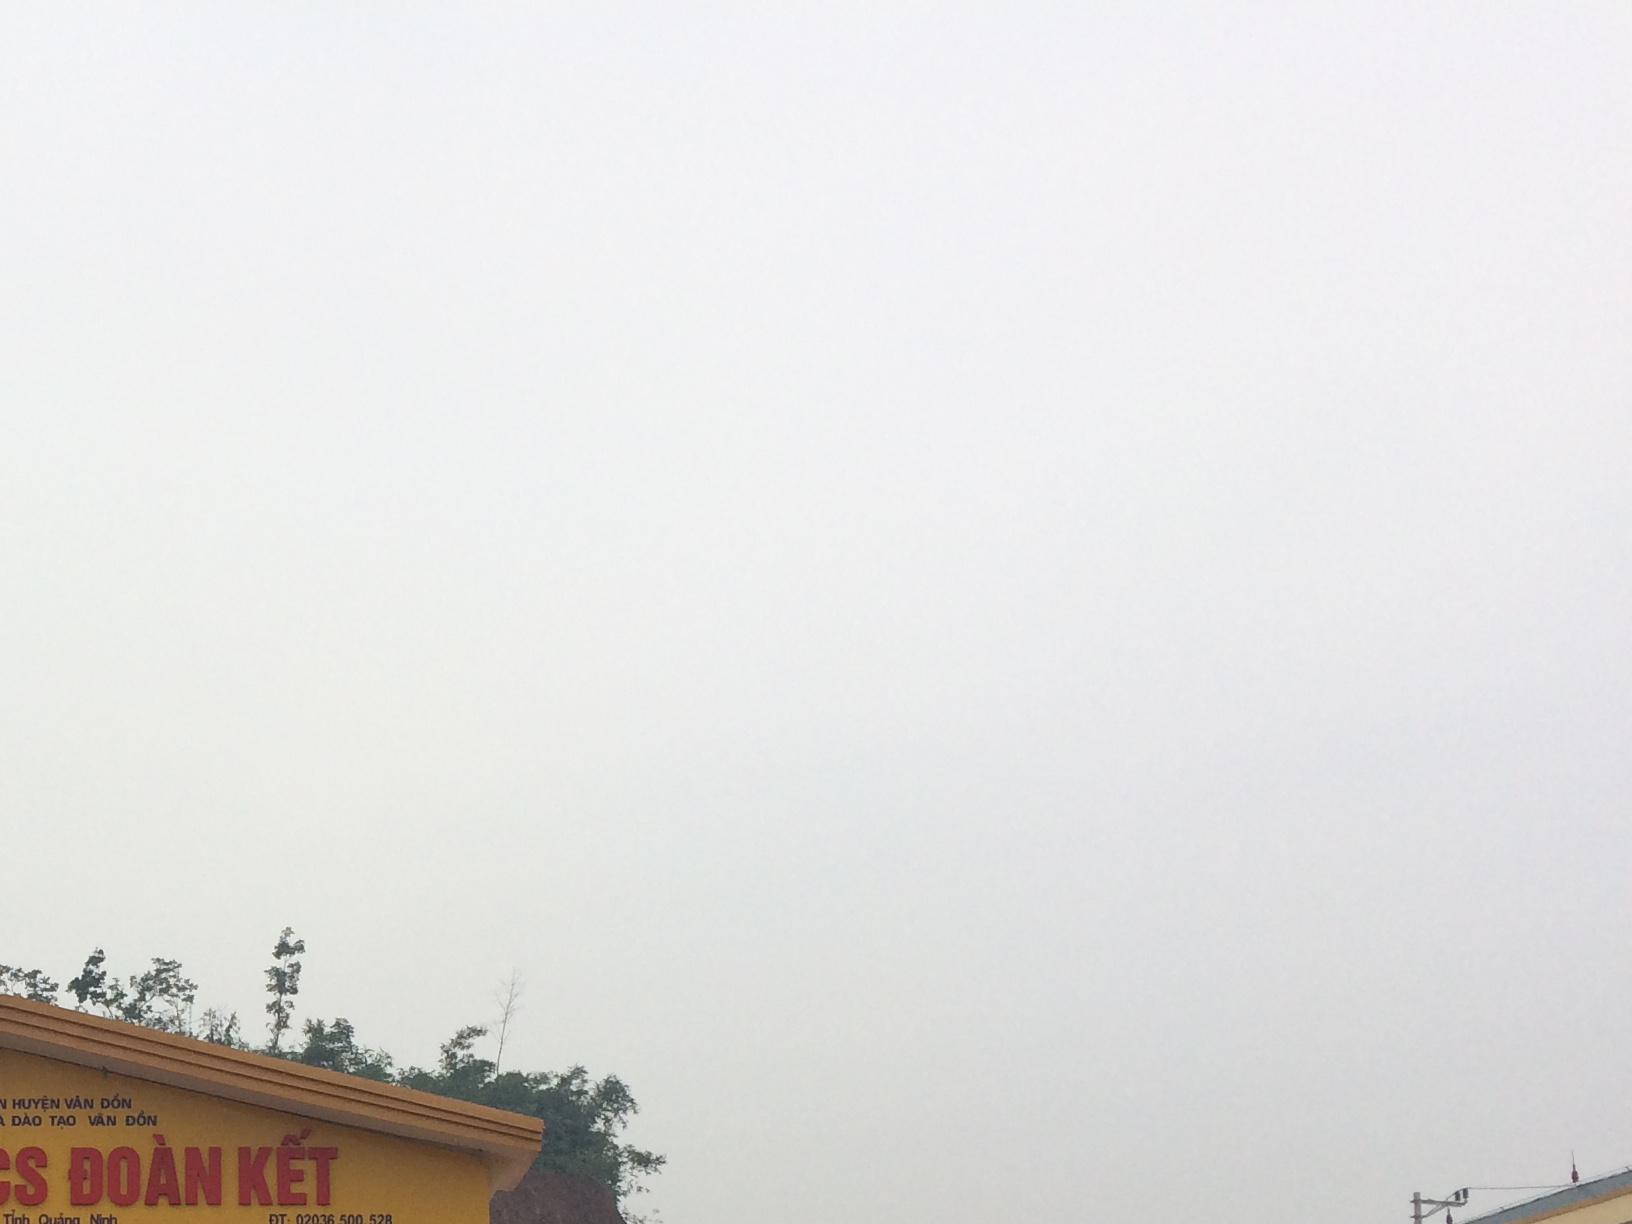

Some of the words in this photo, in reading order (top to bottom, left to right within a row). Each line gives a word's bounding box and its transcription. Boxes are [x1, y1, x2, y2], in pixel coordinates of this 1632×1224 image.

[13, 1096, 60, 1112] HUYỆN
[65, 1095, 94, 1109] VÂN
[11, 1113, 42, 1126] ĐÀO
[49, 1115, 76, 1130] TẠO
[88, 1113, 116, 1126] VÂN
[68, 1134, 222, 1206] ĐOÀN
[238, 1129, 338, 1206] KẾT
